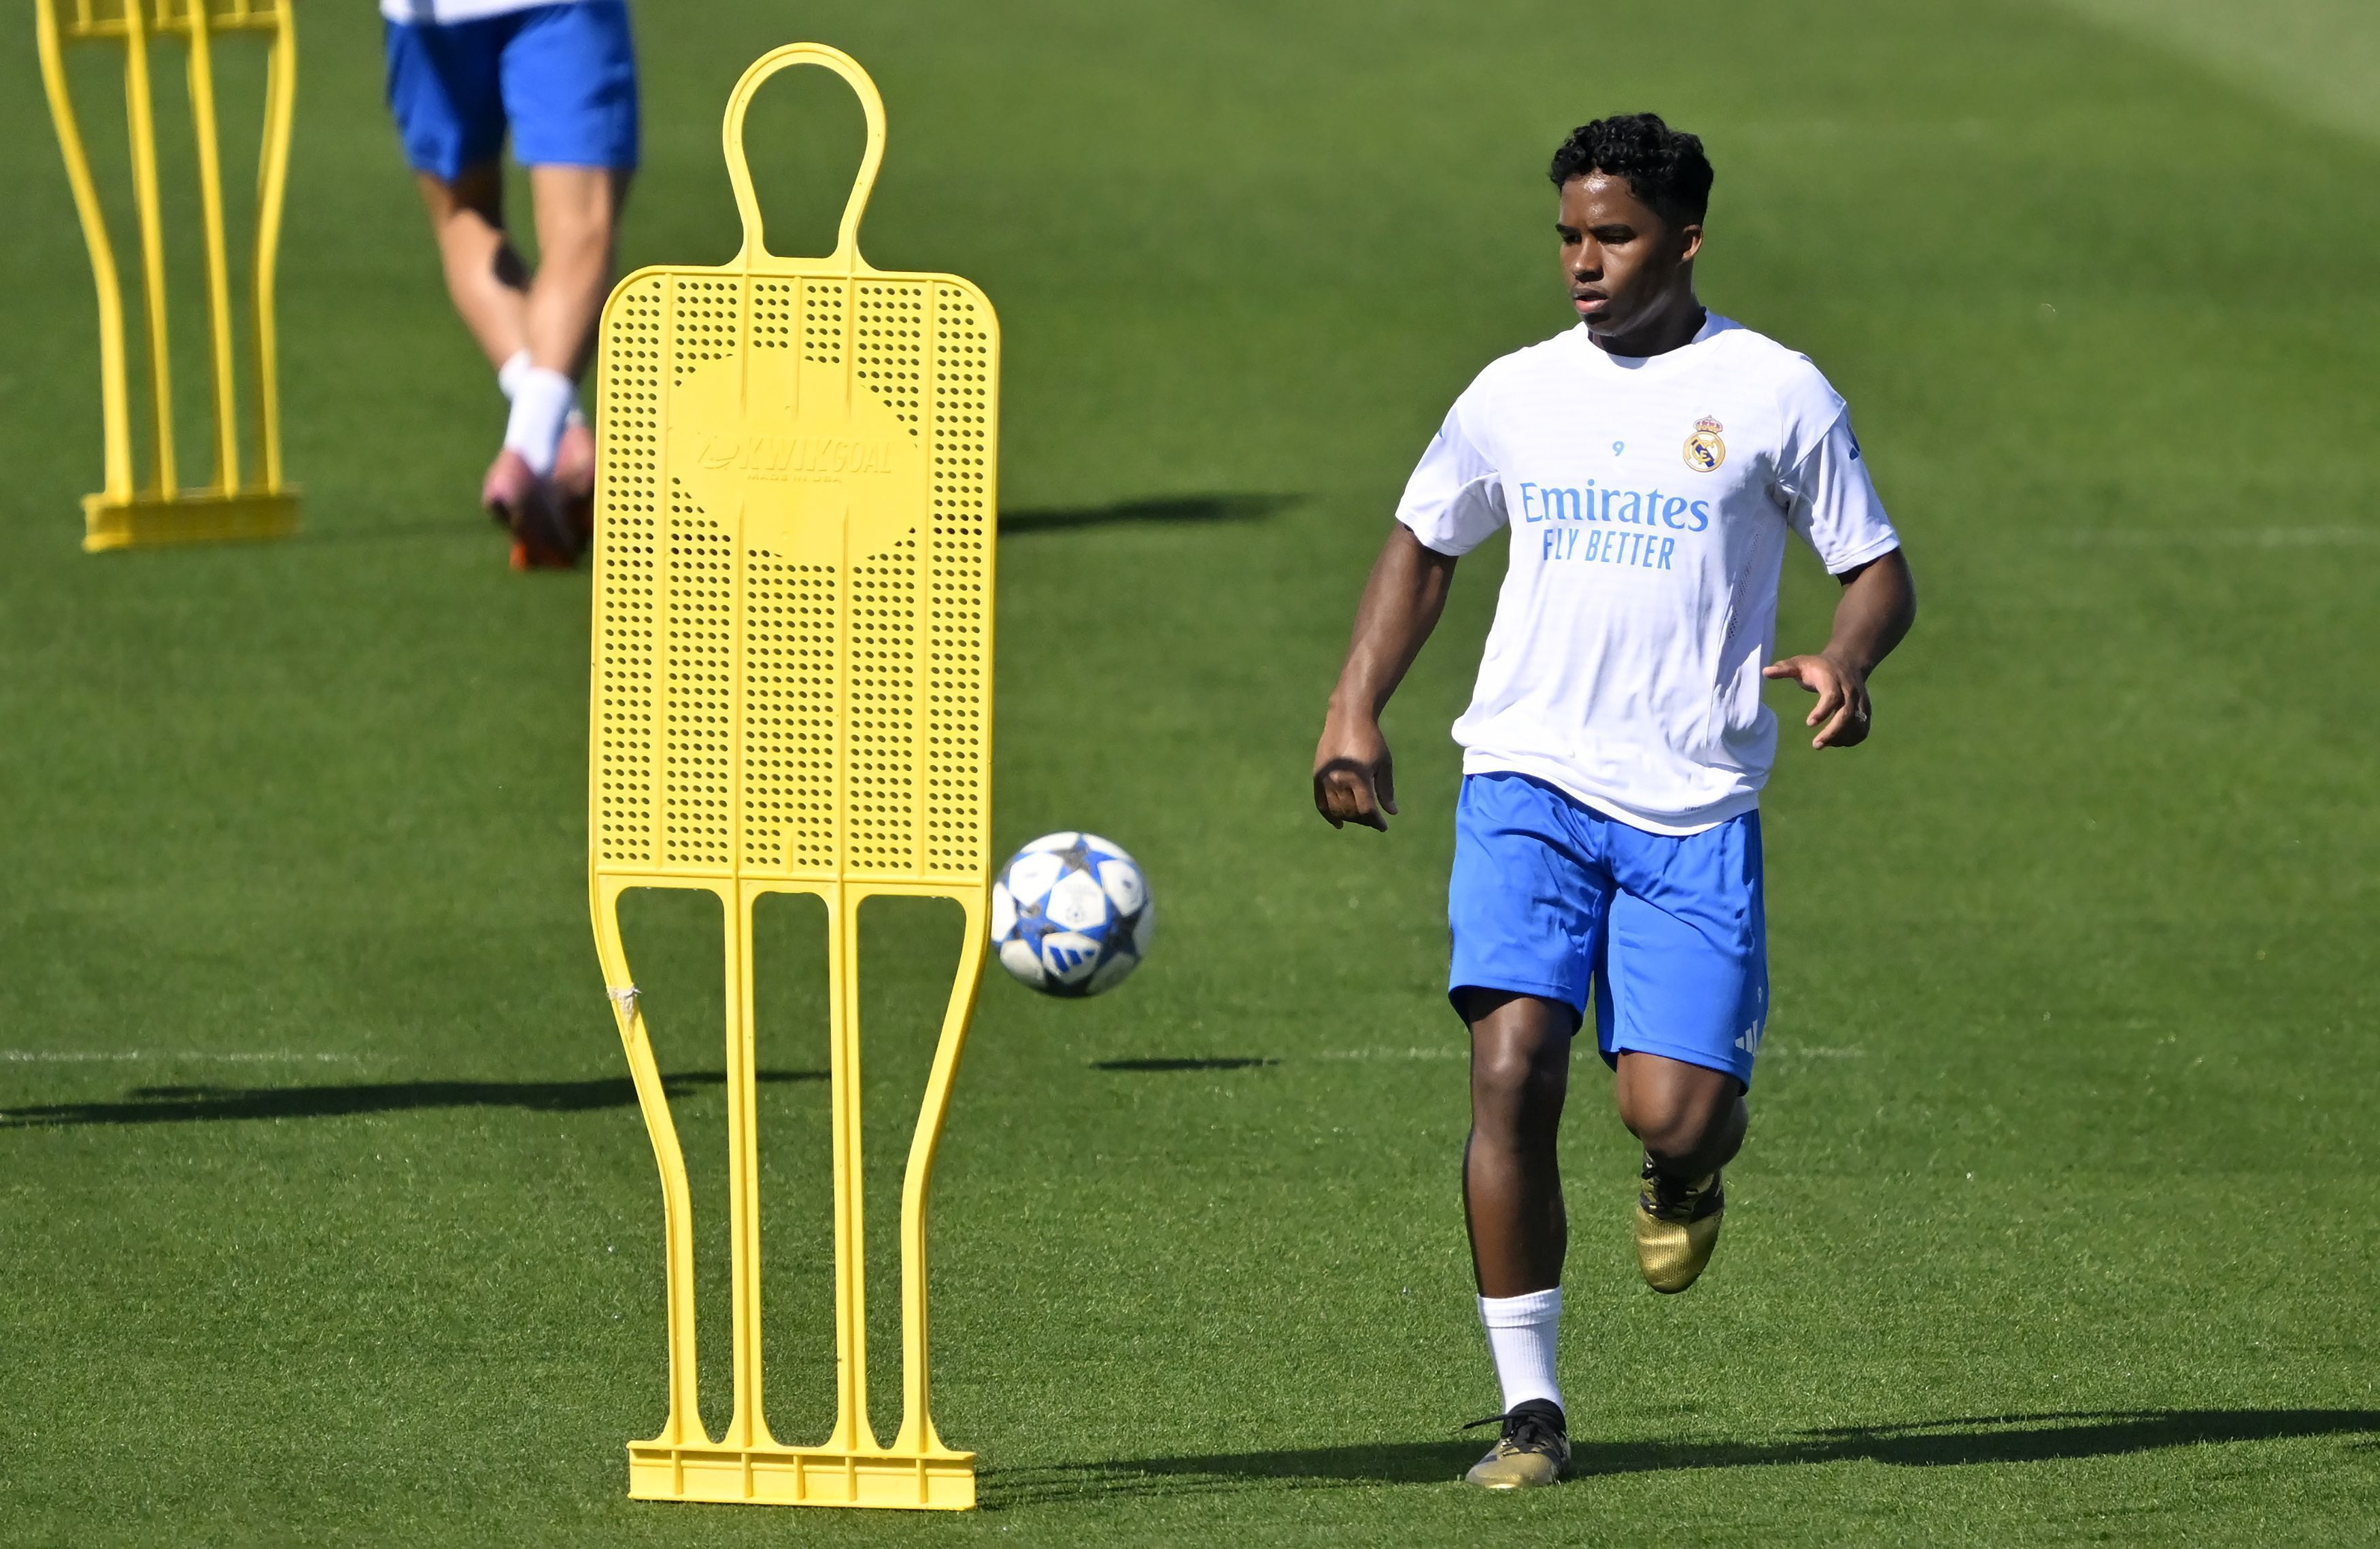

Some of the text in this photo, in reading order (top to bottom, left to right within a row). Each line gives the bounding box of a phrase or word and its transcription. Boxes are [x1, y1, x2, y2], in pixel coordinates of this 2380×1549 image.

[1612, 441, 1625, 457] 9
[747, 473, 843, 483] MADE IN USA
[1520, 479, 1710, 532] Emirates
[1543, 528, 1675, 570] FLY BETTER
